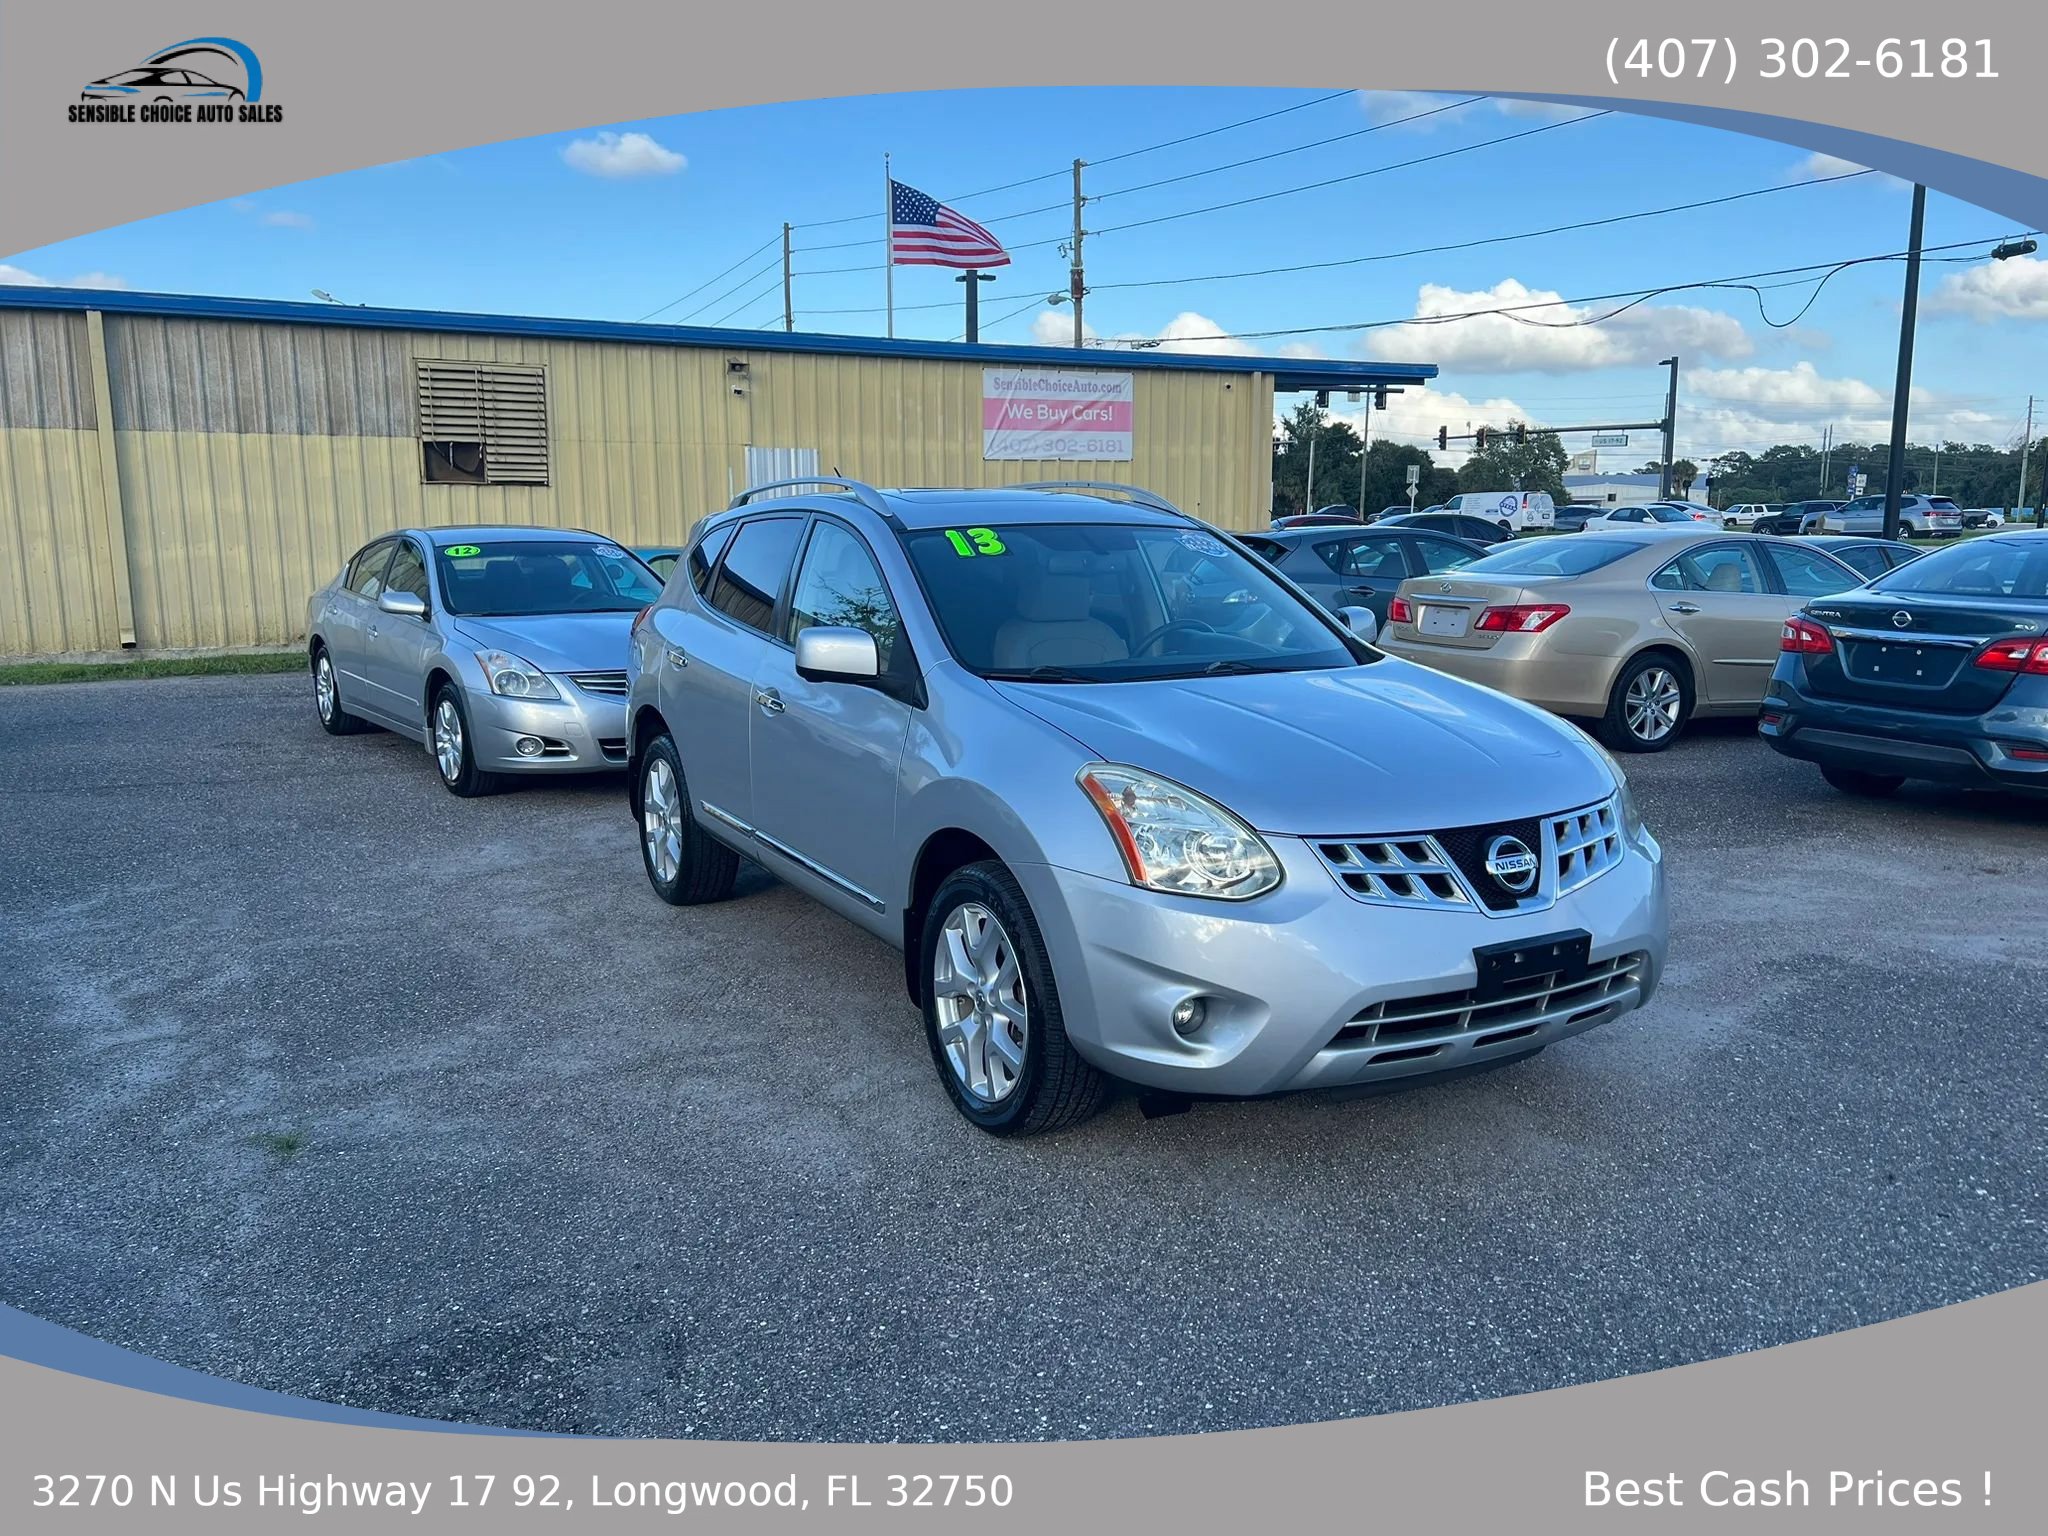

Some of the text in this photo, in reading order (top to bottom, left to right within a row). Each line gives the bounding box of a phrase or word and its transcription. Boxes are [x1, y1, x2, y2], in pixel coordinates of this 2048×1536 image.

[993, 377, 1122, 394] SensibleChoiceAuto.com
[1006, 403, 1114, 424] We Buy Cars!
[1043, 439, 1124, 453] 302-6181
[944, 527, 1006, 557] 13
[454, 546, 472, 555] 12
[1495, 857, 1537, 871] NISSAN
